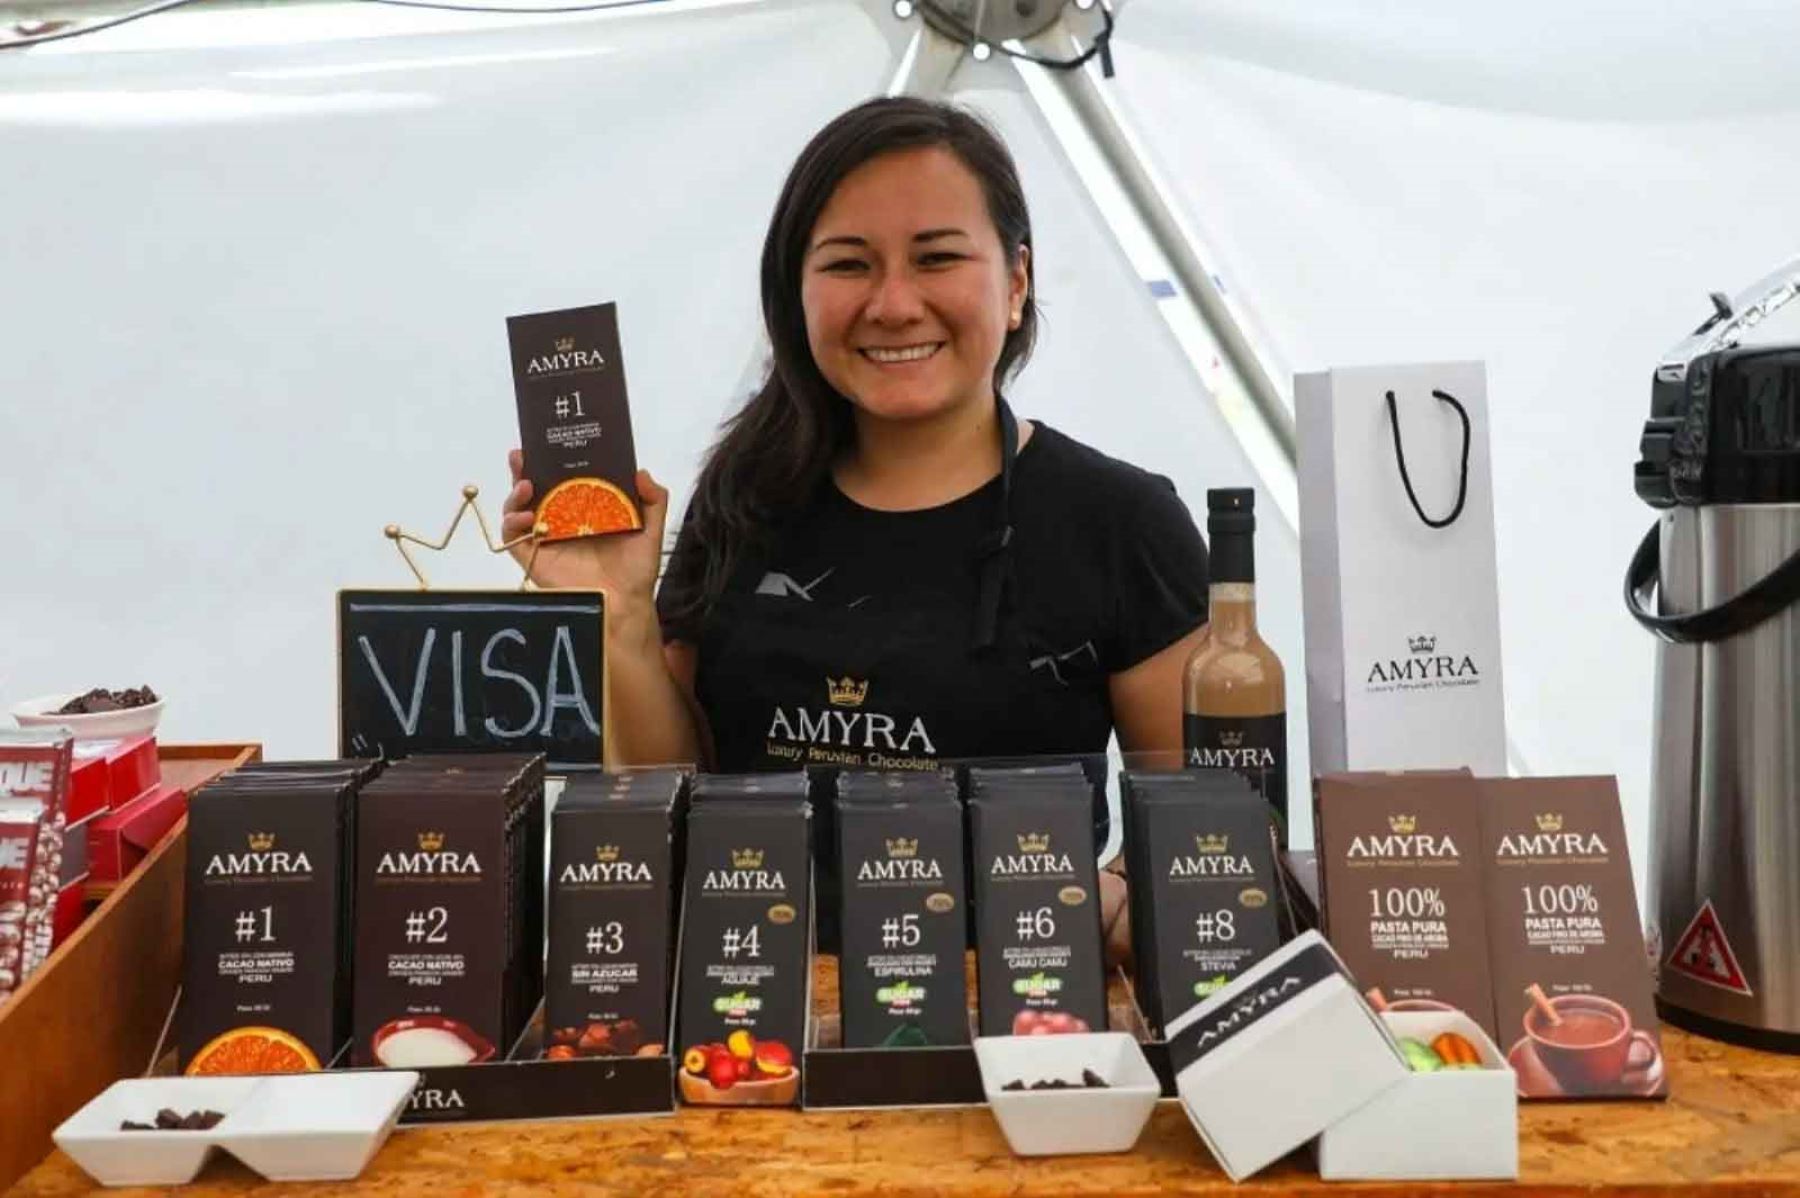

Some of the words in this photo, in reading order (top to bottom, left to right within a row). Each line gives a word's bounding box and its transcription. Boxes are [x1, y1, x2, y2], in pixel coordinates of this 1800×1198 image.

[527, 349, 604, 374] AMYRA
[556, 391, 586, 419] #1
[1368, 656, 1478, 682] AMYRA
[357, 626, 601, 737] VISA
[768, 706, 936, 753] AMYRA
[767, 742, 803, 761] Luxury
[809, 747, 860, 764] Peruvian
[868, 752, 938, 770] Chocolate
[1190, 747, 1275, 767] AMYRA
[1347, 835, 1460, 857] AMYRA
[1497, 832, 1608, 856] AMYRA
[206, 851, 313, 875] AMYRA
[376, 852, 482, 873] AMYRA
[560, 862, 653, 882] AMYRA
[857, 859, 943, 880] AMYRA
[991, 853, 1075, 874] AMYRA
[1169, 855, 1254, 875] AMYRA
[702, 871, 786, 889] AMYRA
[1369, 888, 1446, 918] 100%
[1521, 884, 1599, 915] 100%
[235, 905, 276, 942] #1
[406, 907, 449, 943] #2
[881, 913, 921, 949] #5
[1016, 906, 1056, 941] #6
[1196, 909, 1235, 942] #8
[1371, 921, 1410, 934] PASTA
[1412, 921, 1447, 934] PURA
[1525, 917, 1565, 930] PASTA
[1567, 916, 1603, 929] PURA
[586, 921, 624, 954] #3
[722, 925, 760, 959] #4
[1550, 945, 1585, 955] PERU
[218, 959, 254, 969] CACAO
[257, 958, 294, 968] NATIVO
[388, 961, 424, 970] CACAO
[426, 960, 465, 970] NATIVO
[239, 974, 273, 983] PERU
[408, 976, 442, 986] PERU
[407, 1089, 465, 1109] YRA
